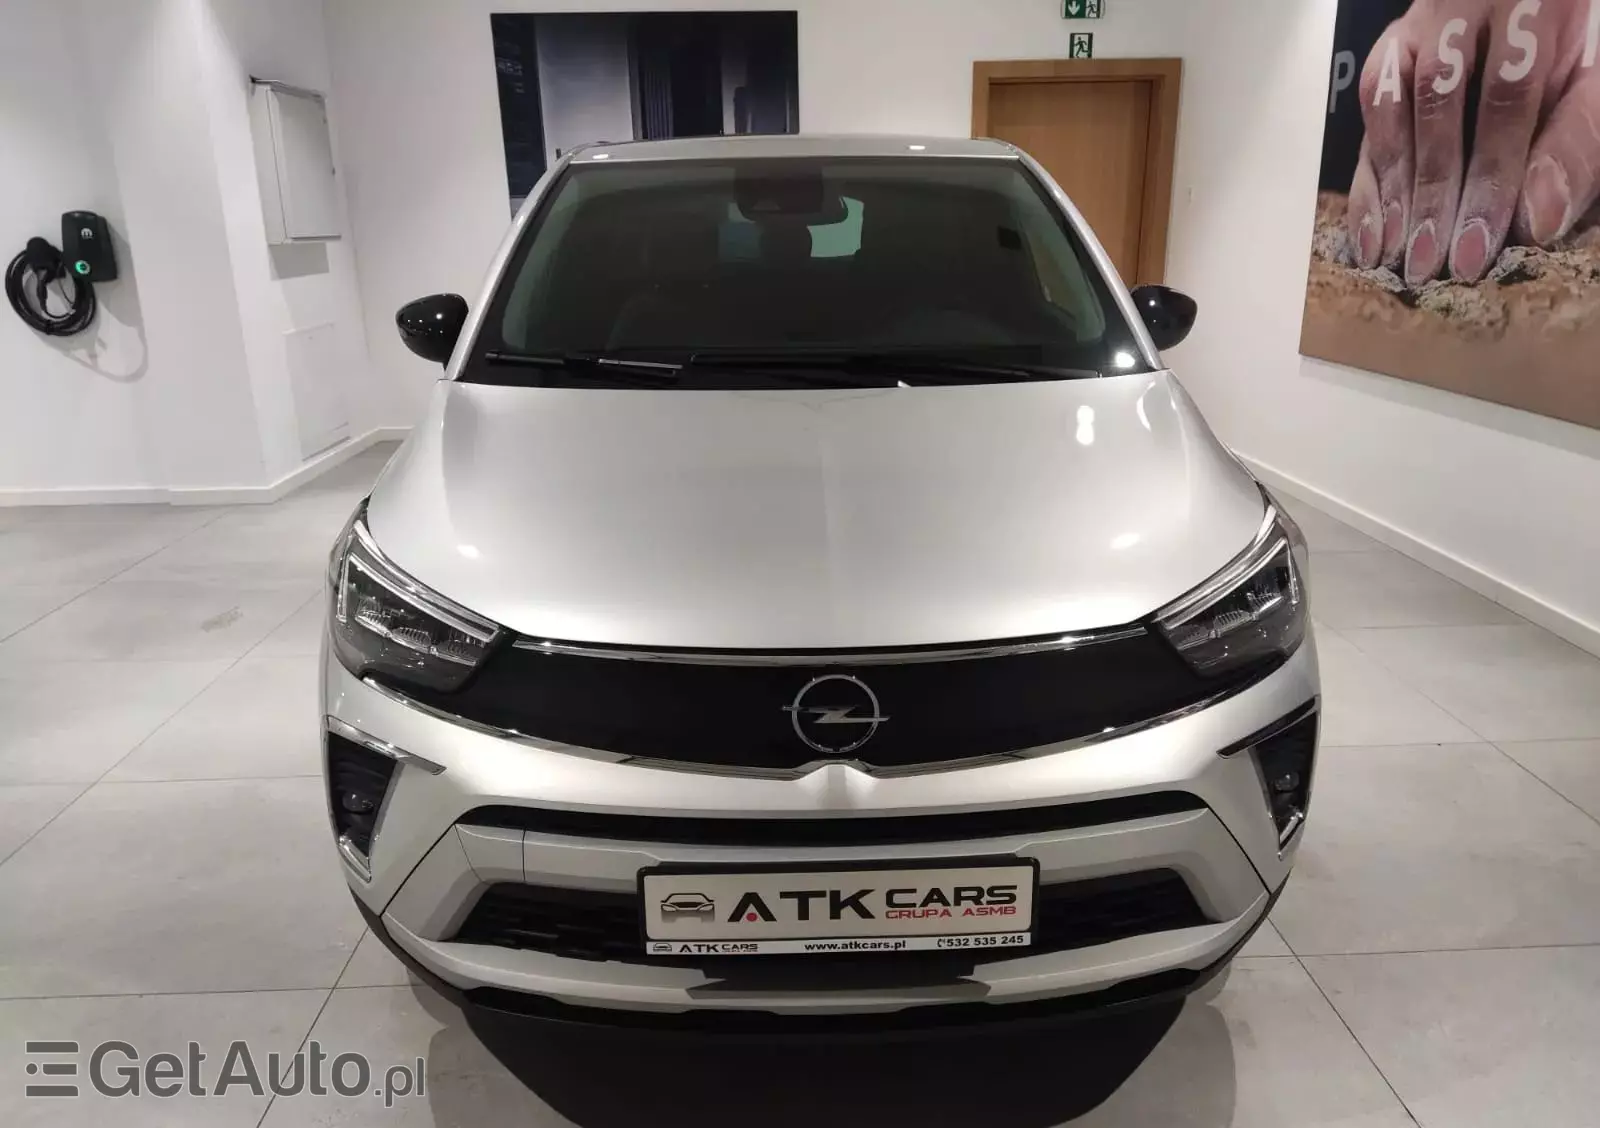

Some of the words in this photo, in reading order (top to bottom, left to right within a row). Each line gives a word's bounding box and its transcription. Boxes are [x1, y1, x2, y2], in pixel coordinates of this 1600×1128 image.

[727, 889, 876, 923] ATK
[885, 885, 1018, 908] CARS
[885, 908, 952, 920] GRUPA
[962, 905, 1017, 917] ASMB
[804, 939, 907, 951] www.atkcars.pl
[946, 938, 971, 947] 532
[973, 936, 997, 946] 535
[1000, 935, 1024, 945] 245
[679, 943, 719, 953] ATK
